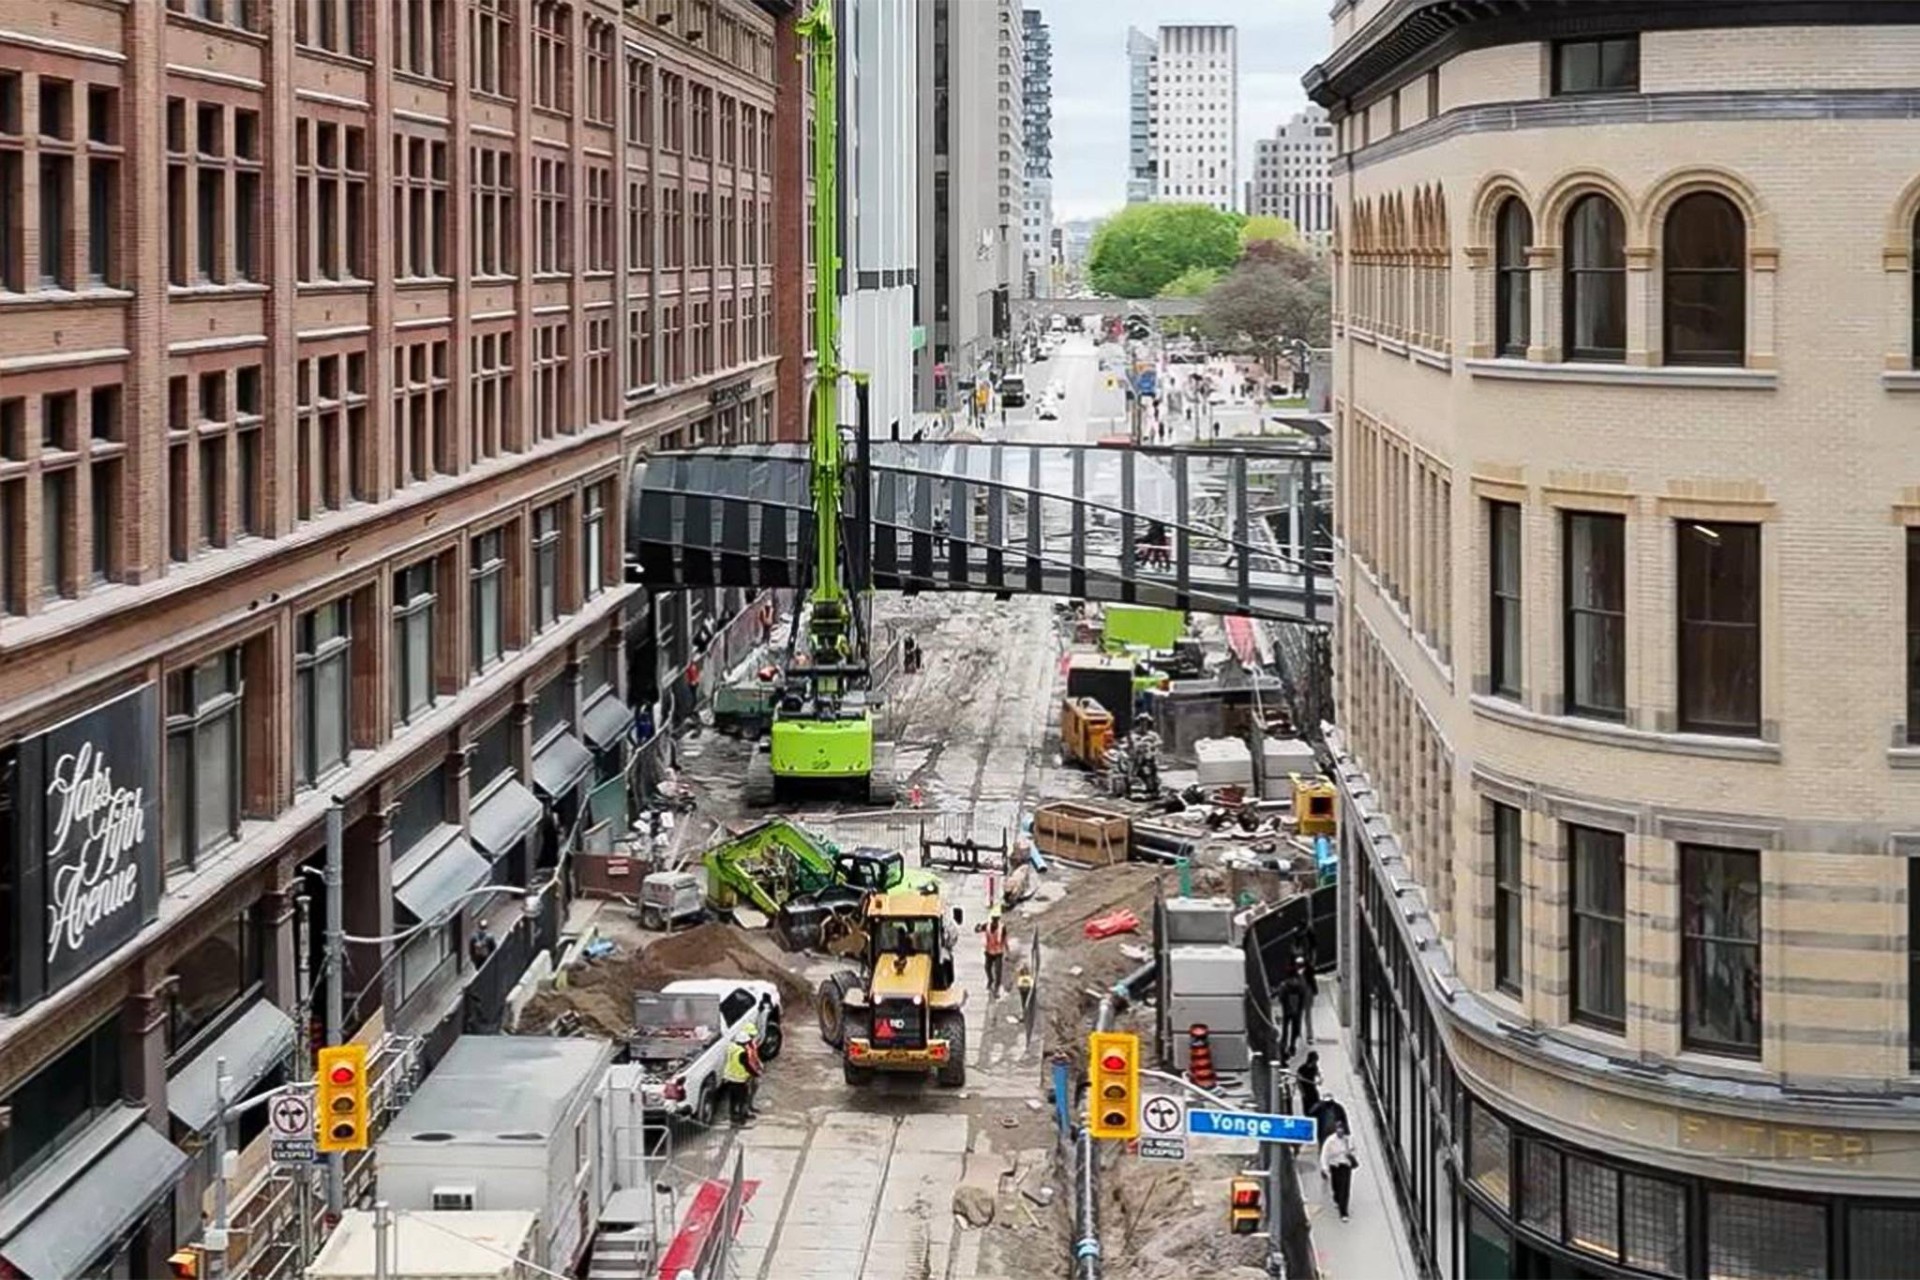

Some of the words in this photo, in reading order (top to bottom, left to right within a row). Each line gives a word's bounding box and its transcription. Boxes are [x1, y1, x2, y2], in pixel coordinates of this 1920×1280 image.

[47, 742, 111, 855] Saks
[80, 787, 145, 885] Fifth
[47, 864, 137, 963] Avenue
[1210, 1113, 1272, 1136] Yonge
